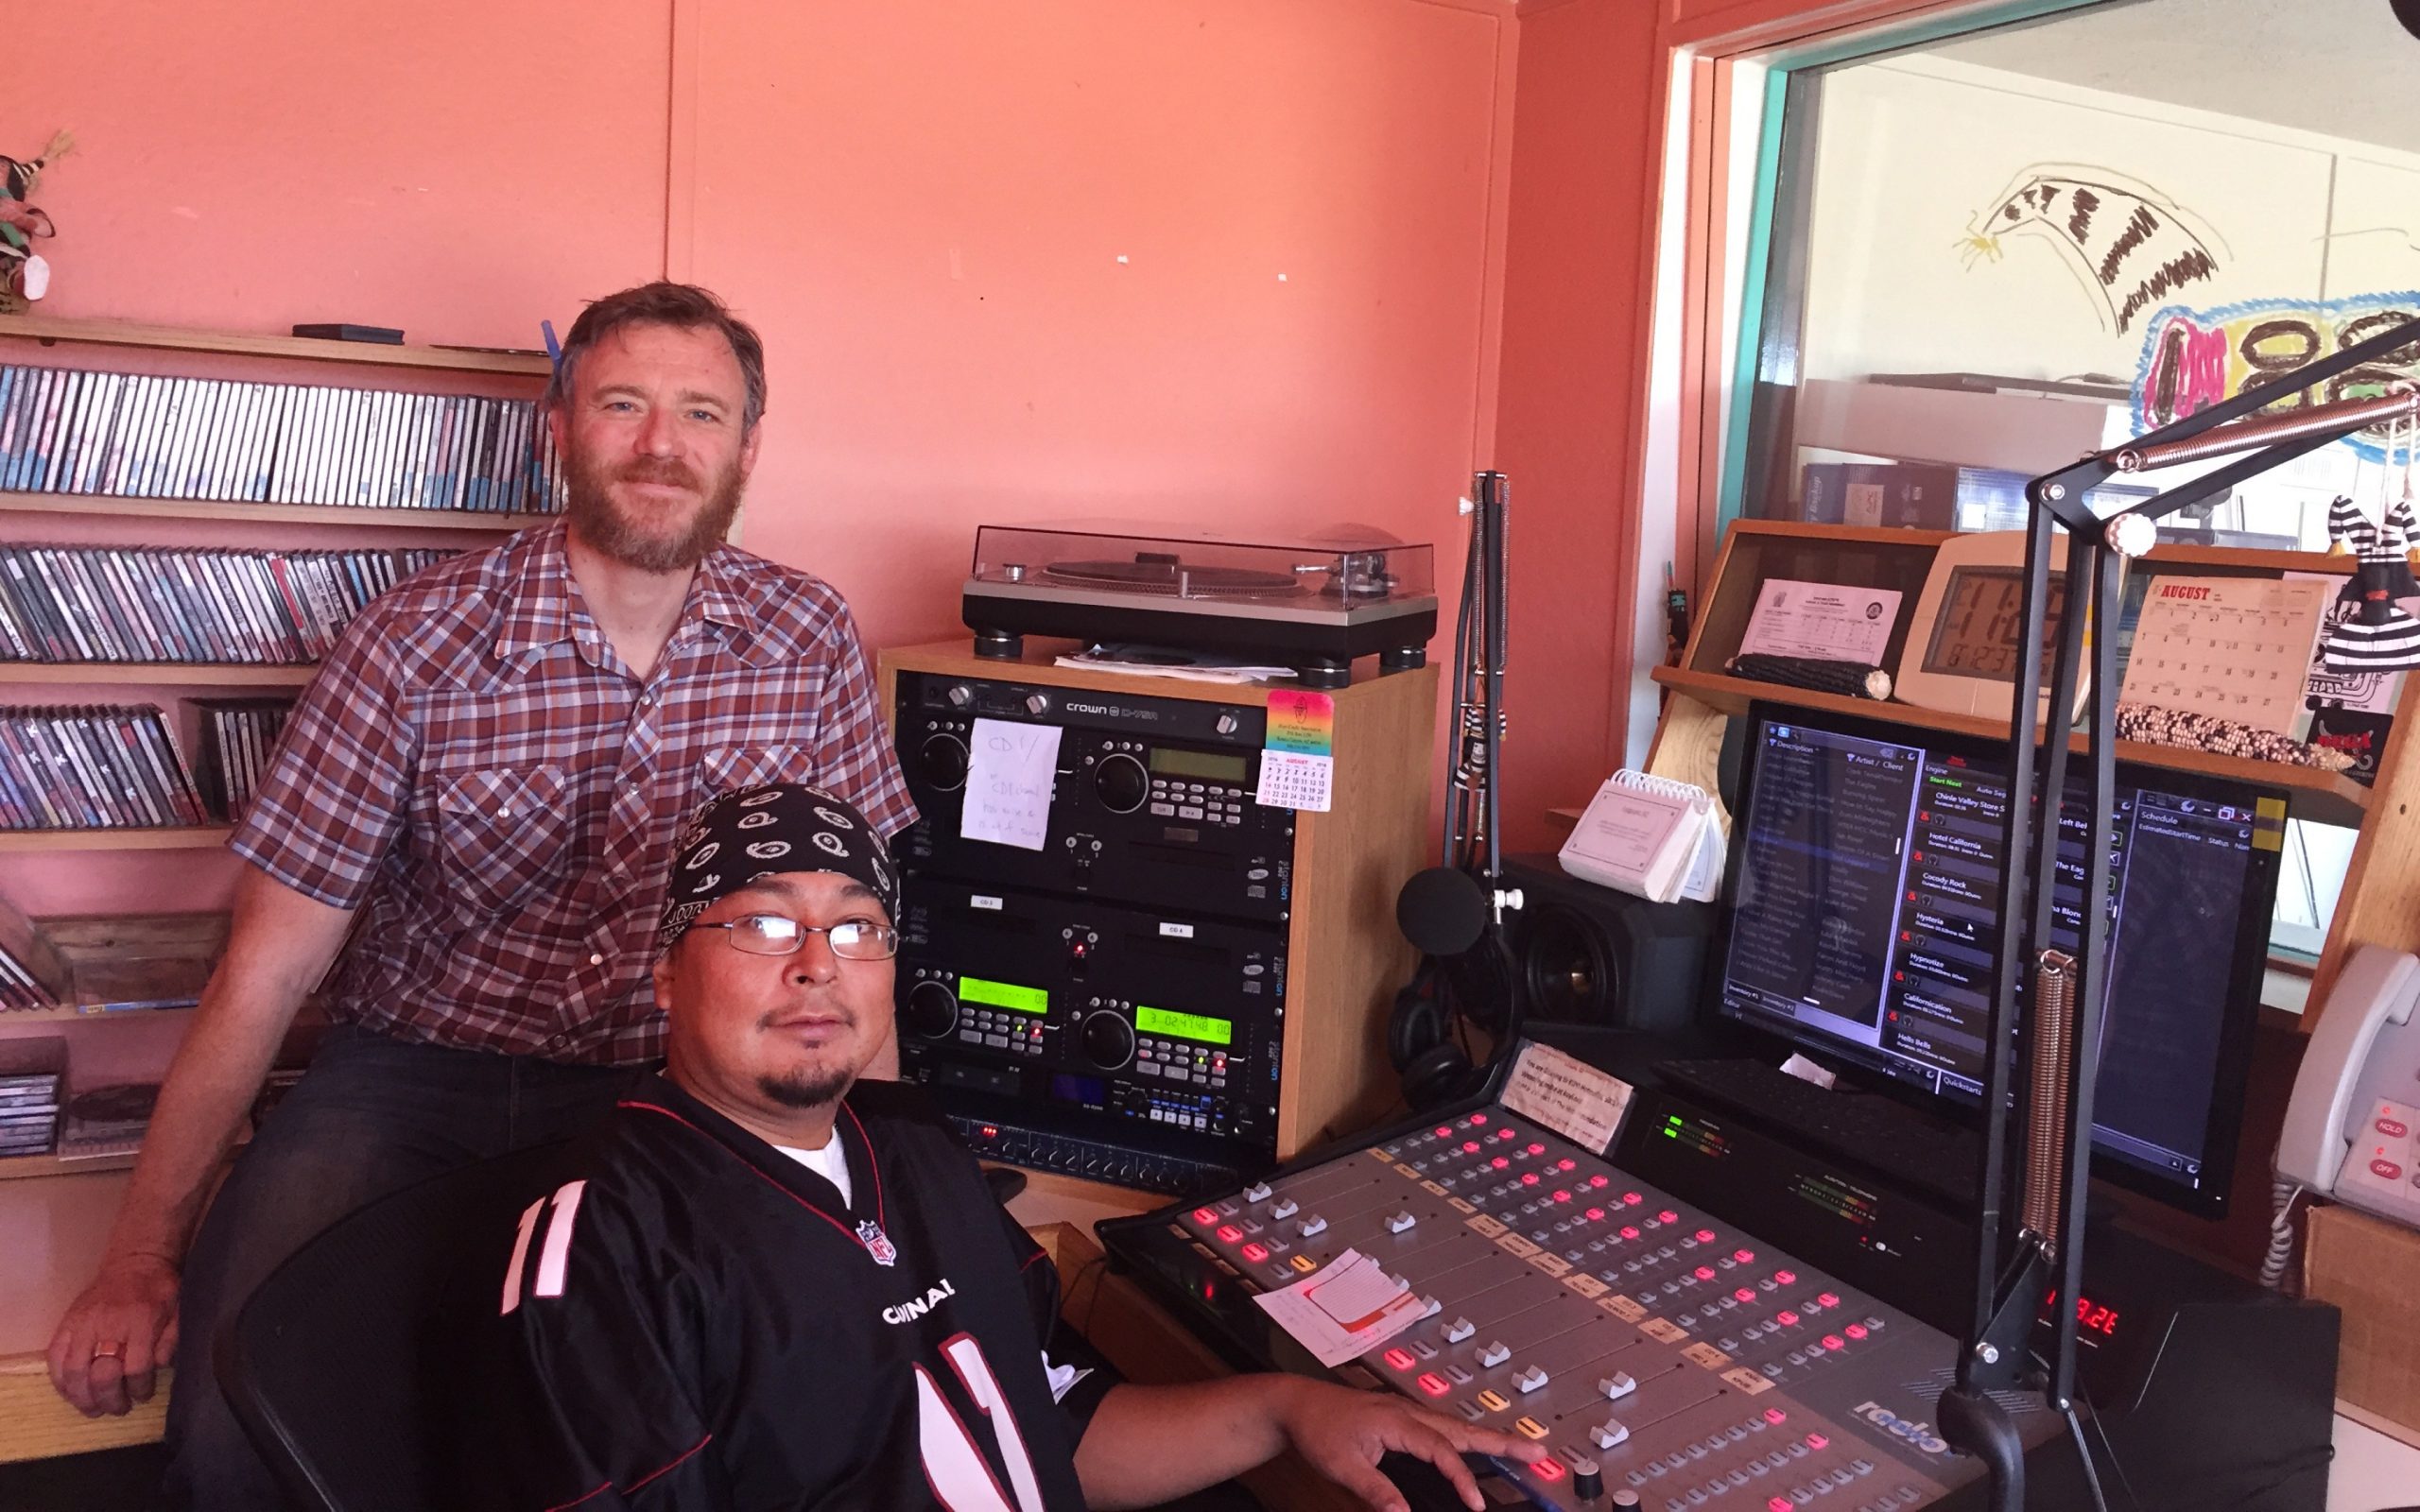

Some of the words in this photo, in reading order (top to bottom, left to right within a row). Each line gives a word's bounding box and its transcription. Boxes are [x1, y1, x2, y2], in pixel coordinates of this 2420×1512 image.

[2160, 585, 2211, 601] AUGUST
[1066, 703, 1107, 714] crown
[1777, 740, 1813, 754] Description
[1855, 756, 1875, 766] Artist
[1883, 761, 1904, 772] Client
[1925, 765, 1948, 776] Engine
[1929, 775, 1947, 786] Start
[1948, 779, 1962, 788] Next
[1977, 786, 1993, 796] Auto
[1935, 792, 1957, 804] Chinle
[1959, 796, 1979, 809] Valley
[1979, 800, 1998, 812] Store
[2059, 816, 2073, 828] Left
[2141, 811, 2178, 825] Schedule
[1929, 832, 1948, 844] Hotel
[1948, 836, 1981, 850] California
[2138, 824, 2202, 842] EstimatedStartTime
[2208, 836, 2230, 848] Status
[2055, 860, 2069, 871] The
[2070, 864, 2084, 875] Eag
[1923, 871, 1947, 885] Cocody
[1948, 878, 1966, 889] Rock
[1916, 912, 1944, 925] Hysteria
[1910, 952, 1945, 968] Hypnotize
[1723, 998, 1740, 1009] Editor
[1728, 985, 1752, 998] Inventory
[1762, 995, 1786, 1009] Inventory
[1904, 992, 1952, 1013] Californication
[1897, 1032, 1914, 1044] Hells
[1915, 1038, 1931, 1050] Bells
[1943, 1076, 1982, 1096] Quickstarts
[2377, 1121, 2402, 1134] HOLD
[2376, 1163, 2394, 1174] OFF
[499, 1179, 588, 1317] 11
[871, 1237, 892, 1259] NFL
